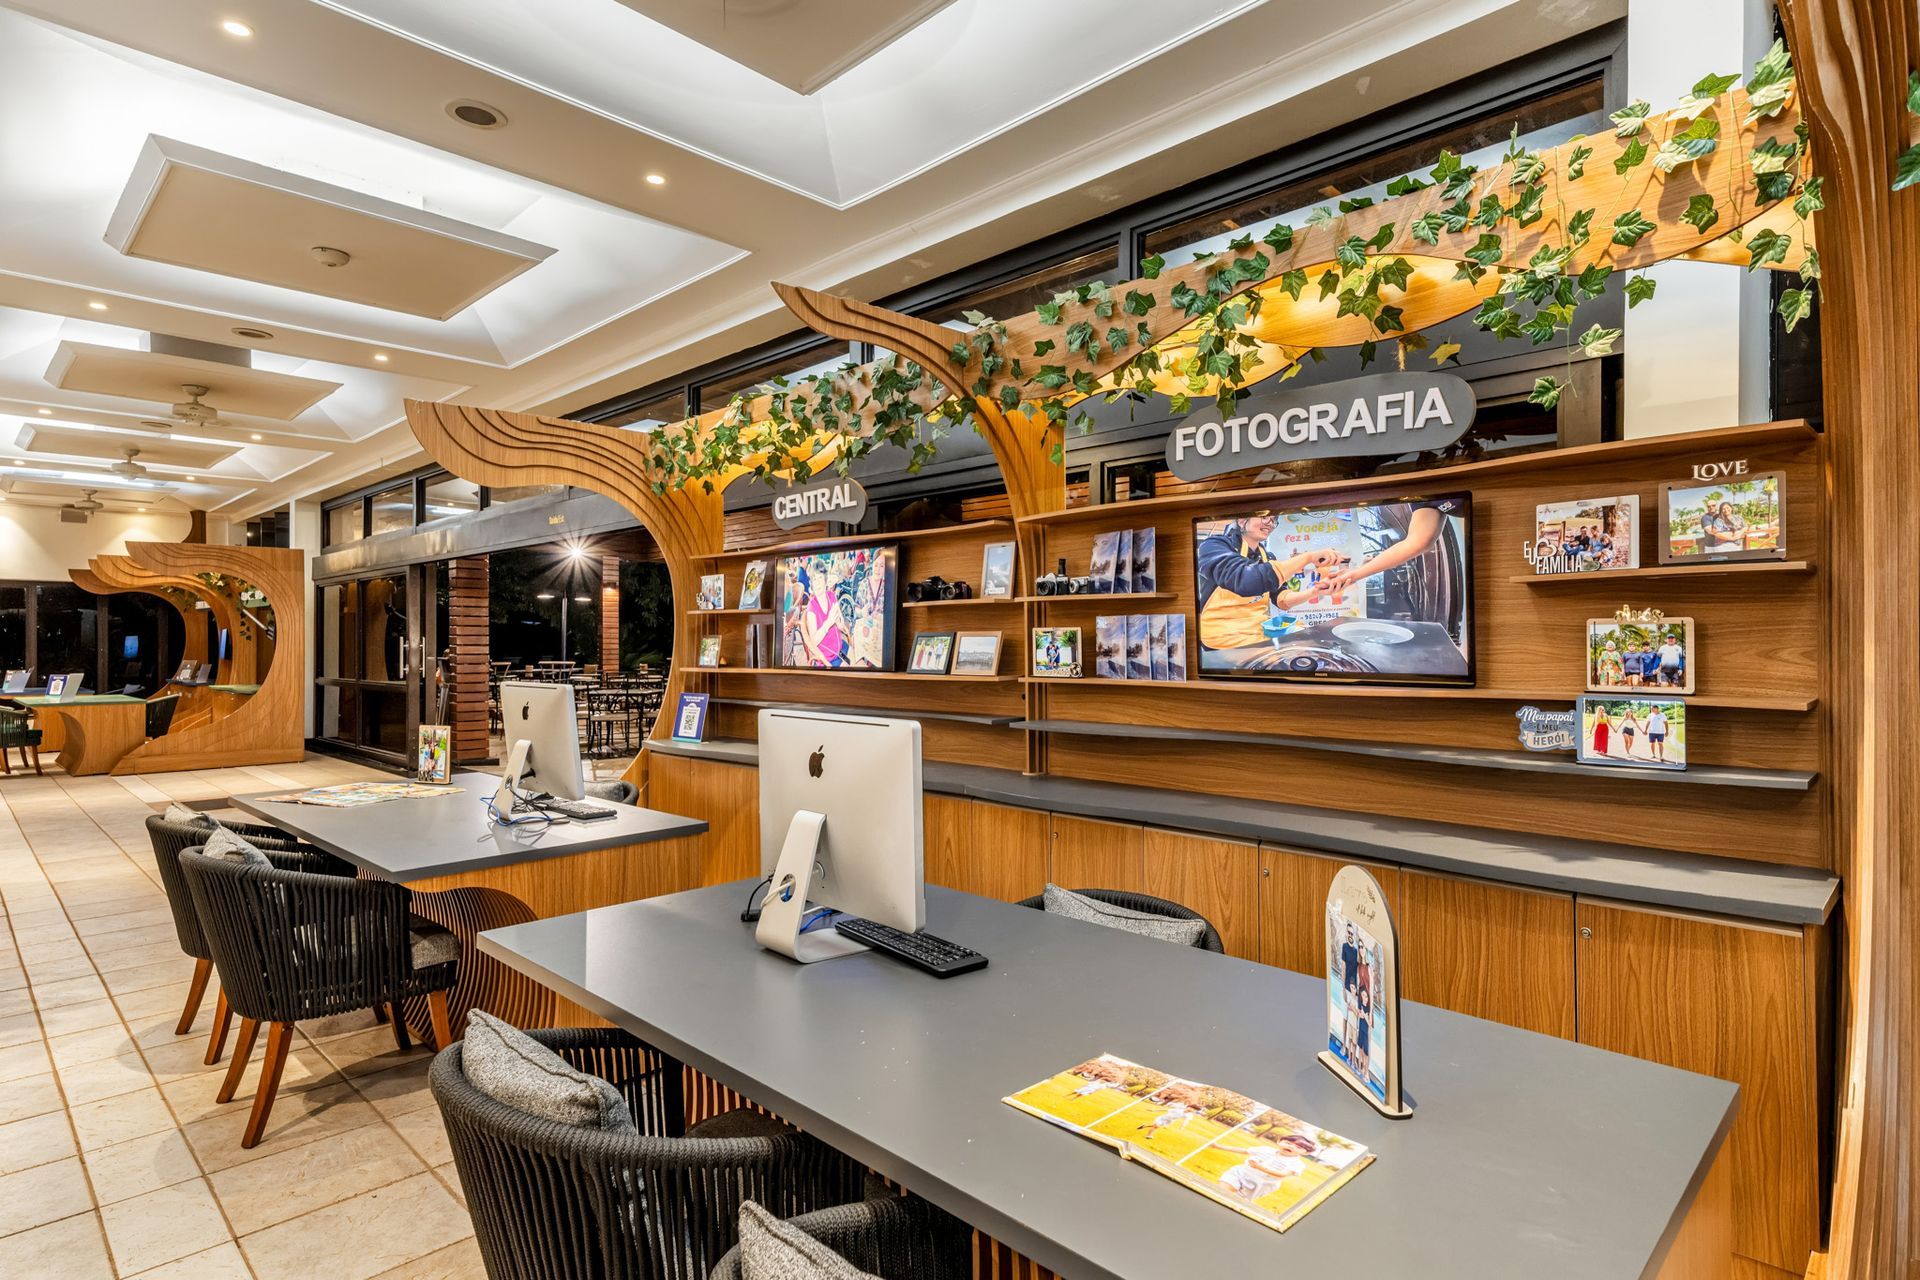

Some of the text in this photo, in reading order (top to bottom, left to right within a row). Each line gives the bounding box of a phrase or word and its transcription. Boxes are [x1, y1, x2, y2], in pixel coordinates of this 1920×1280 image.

[1175, 387, 1453, 461] FOTOGRAFIA
[1691, 458, 1750, 481] LOVE
[774, 483, 857, 520] CENTRAL
[1285, 534, 1301, 543] fez
[1523, 540, 1536, 565] EU
[1536, 552, 1582, 575] FAMÍLIA
[1518, 708, 1575, 725] Meu papai
[1533, 732, 1565, 746] HERÓI
